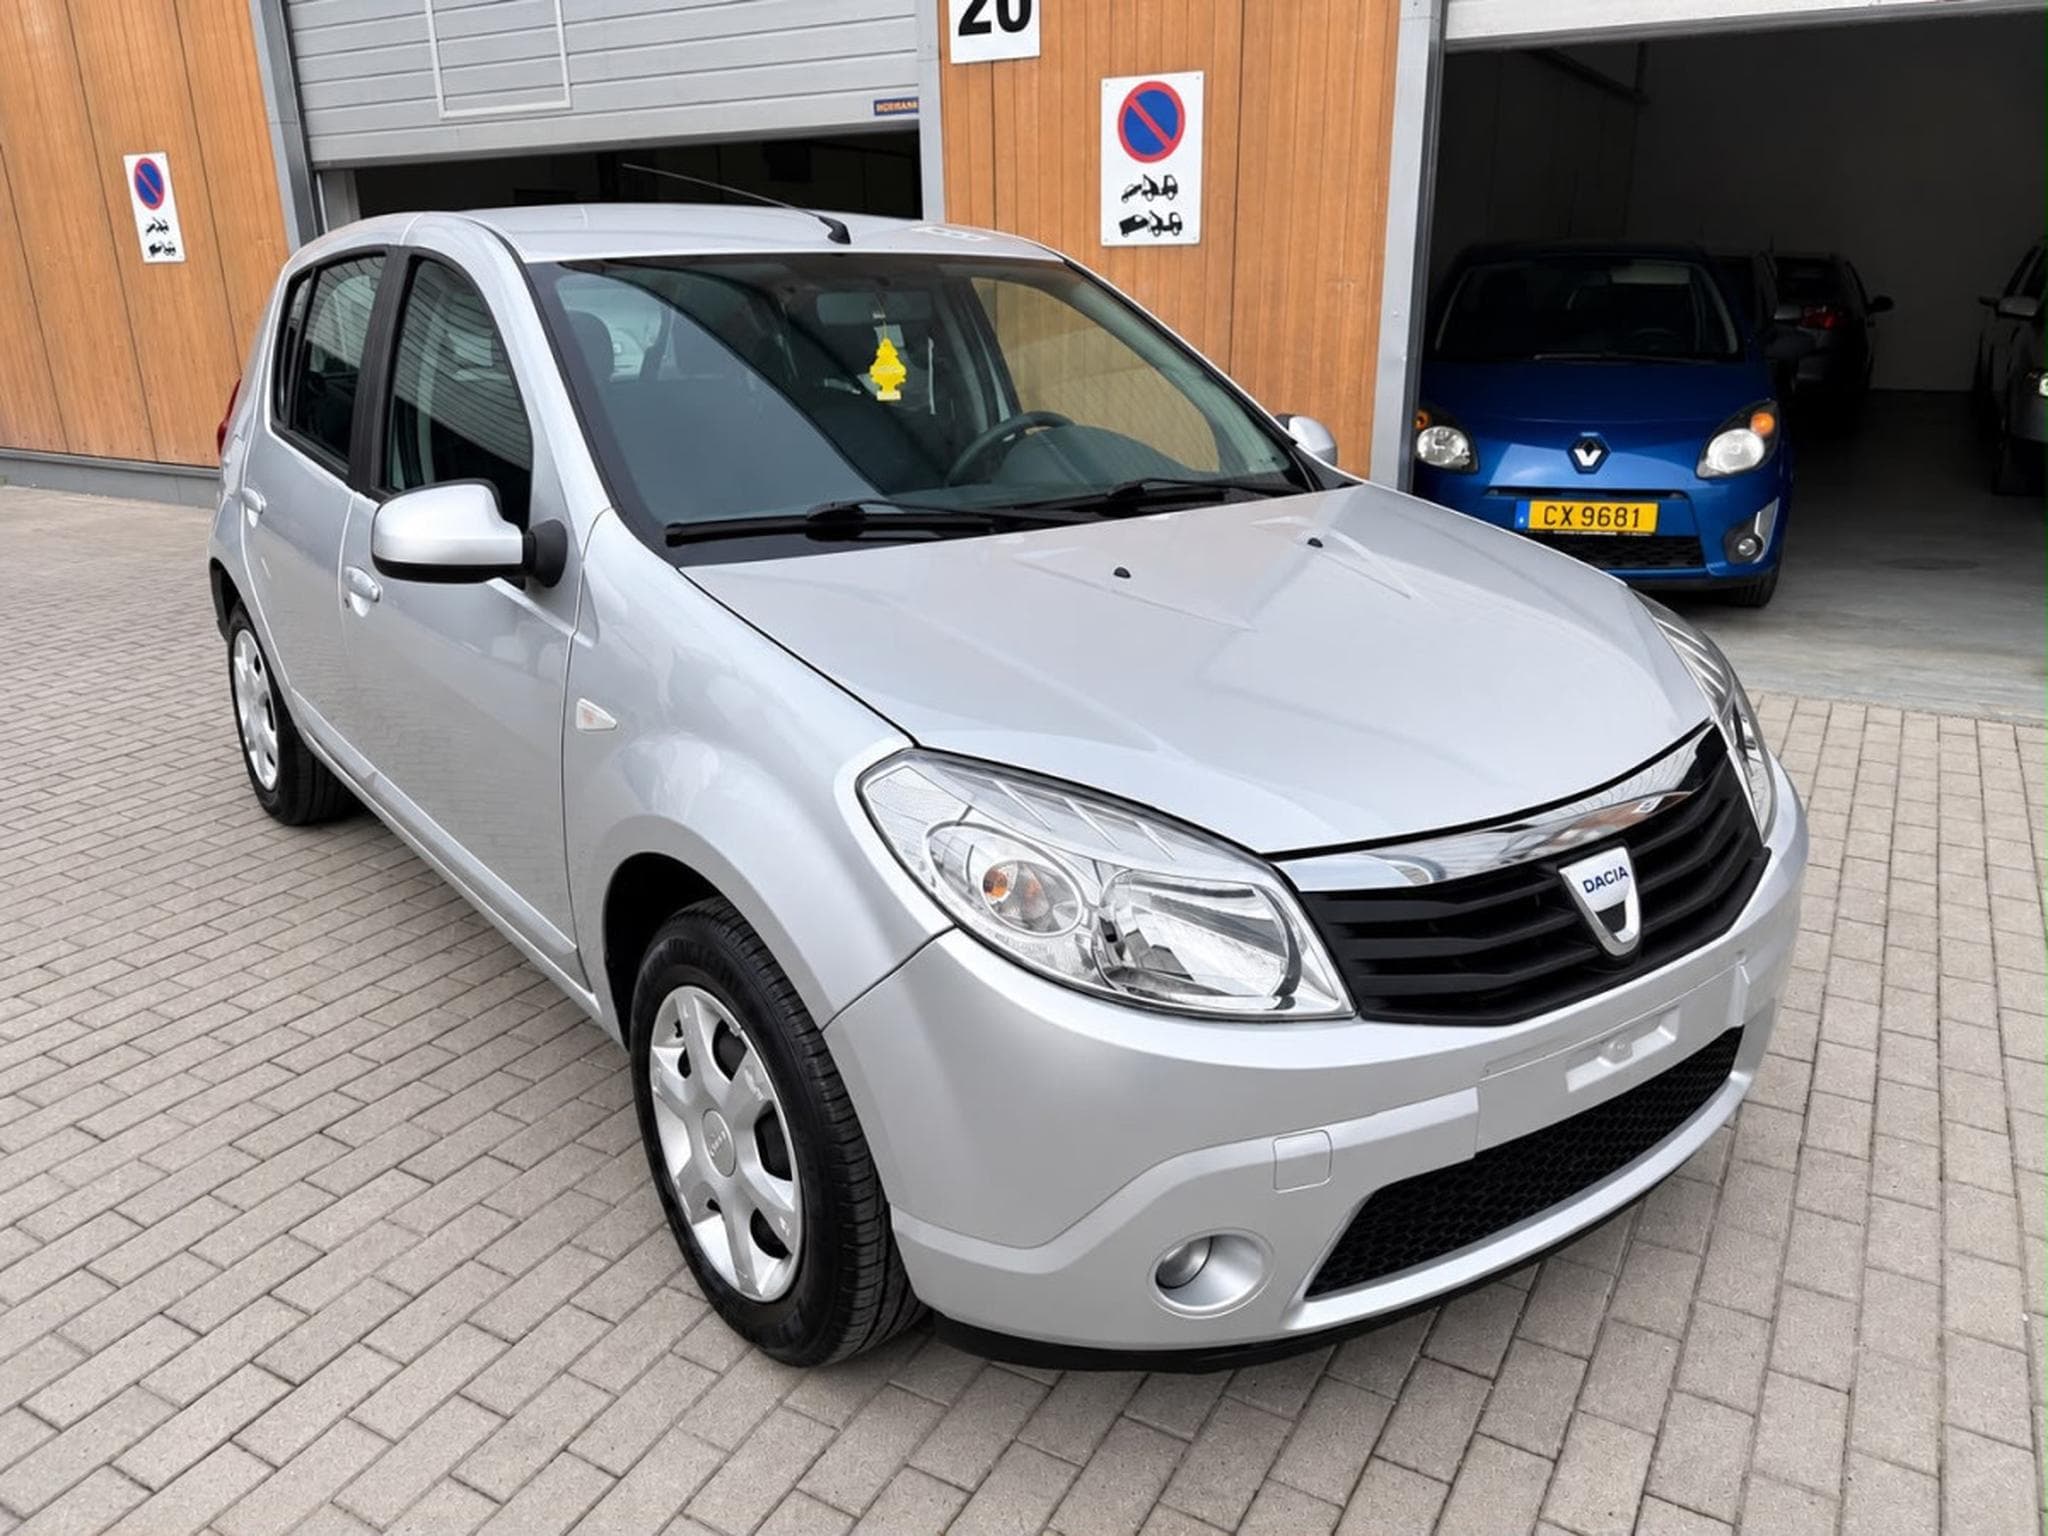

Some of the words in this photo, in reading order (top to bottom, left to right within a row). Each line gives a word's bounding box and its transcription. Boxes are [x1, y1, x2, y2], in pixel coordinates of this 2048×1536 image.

[1543, 505, 1574, 527] CX
[1581, 506, 1640, 528] 9681
[1582, 865, 1629, 893] DACIA
